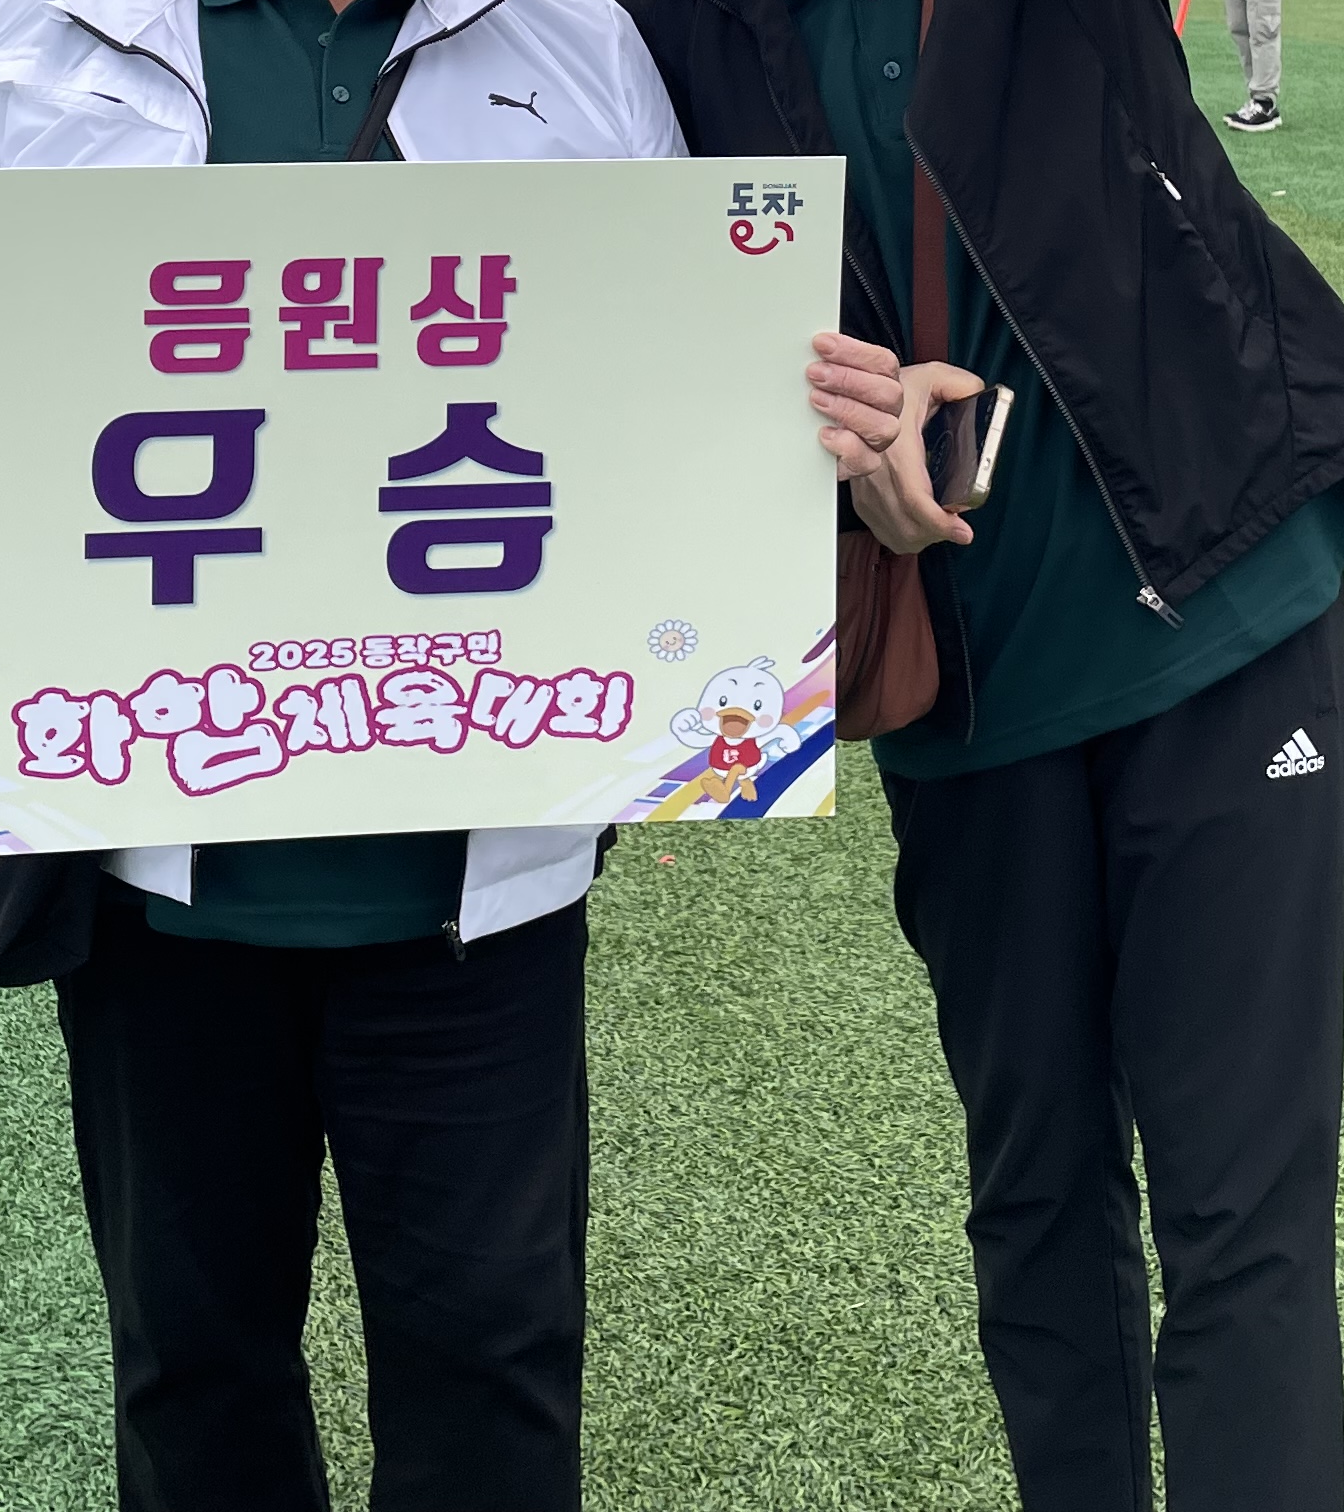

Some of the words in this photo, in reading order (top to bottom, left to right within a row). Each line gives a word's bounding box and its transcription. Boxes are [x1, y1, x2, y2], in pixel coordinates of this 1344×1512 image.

[143, 254, 519, 375] 응원상
[248, 637, 357, 672] 2025
[360, 628, 503, 668] 동작구민
[11, 662, 635, 797] 화합체육대회
[1266, 754, 1325, 779] adidas
